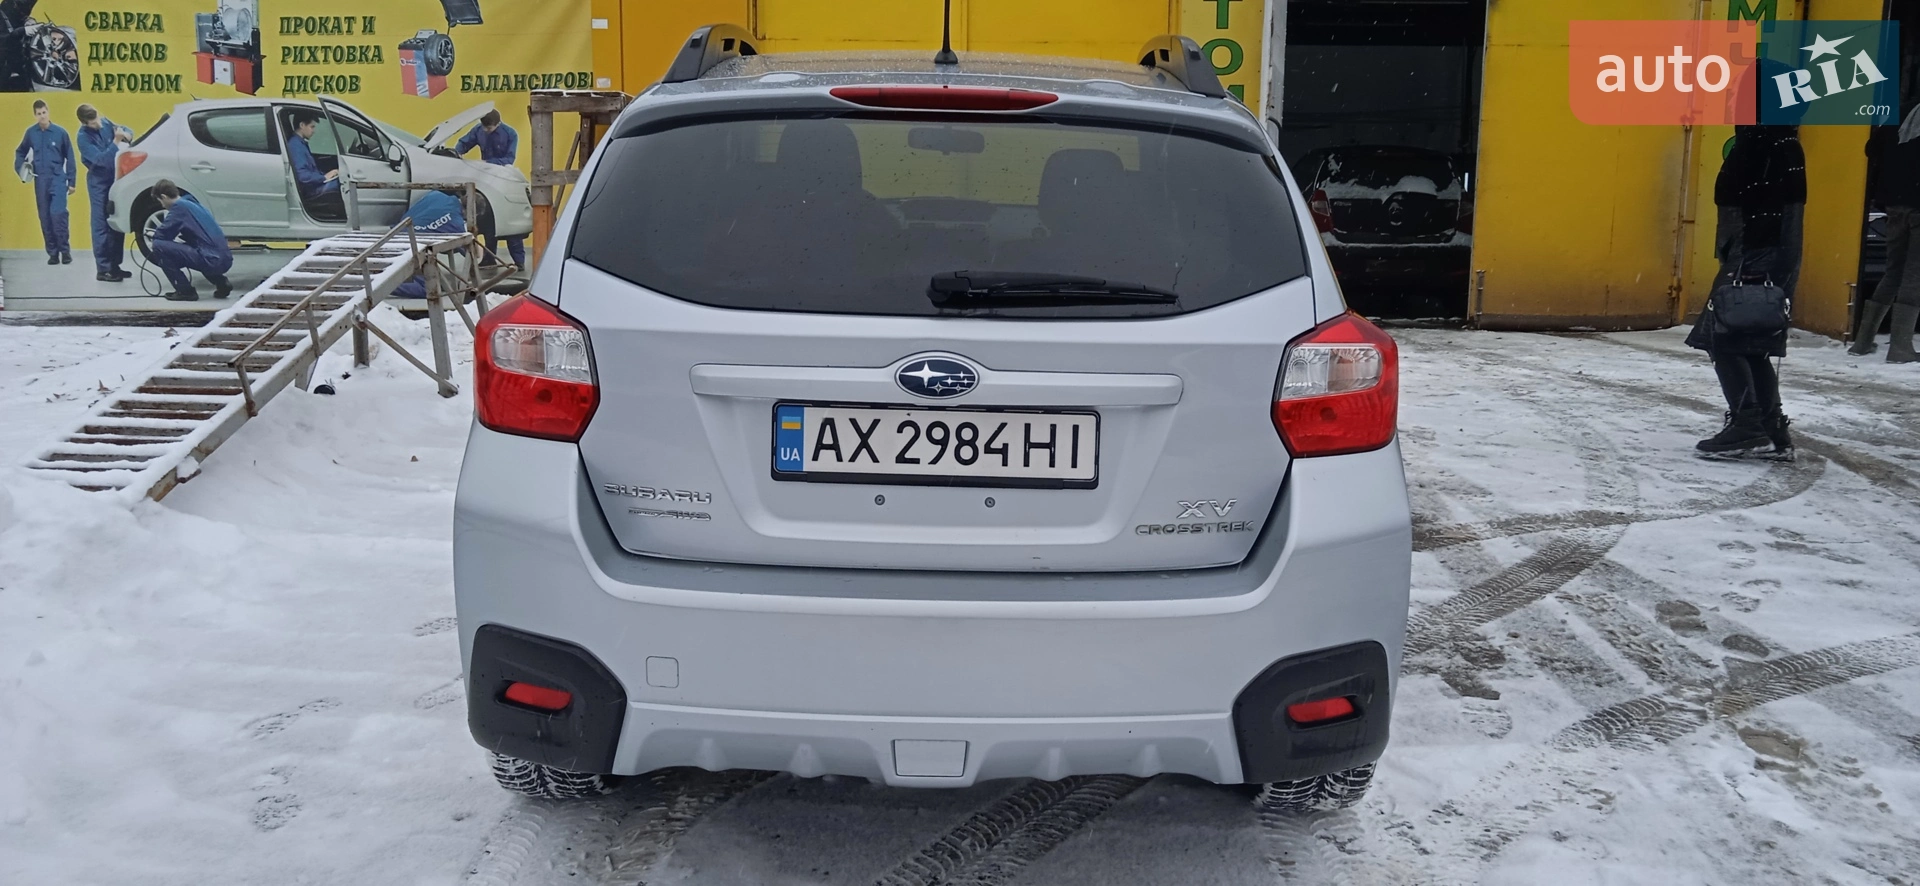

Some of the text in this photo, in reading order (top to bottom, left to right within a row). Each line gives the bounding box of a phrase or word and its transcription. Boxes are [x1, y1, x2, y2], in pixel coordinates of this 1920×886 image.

[85, 11, 164, 33] СВАРКА
[279, 15, 376, 36] ПРОКАТ И
[88, 42, 168, 66] ДИСКОВ
[281, 45, 384, 65] РИХТОВКА
[91, 73, 182, 94] АРГОНОМ
[283, 75, 361, 98] ДИСКОВ
[780, 446, 801, 461] UA
[811, 417, 1080, 469] AX 2984 HI
[604, 483, 712, 505] SUBARU
[1176, 498, 1238, 519] XV
[1135, 520, 1255, 536] CROSSTREK
